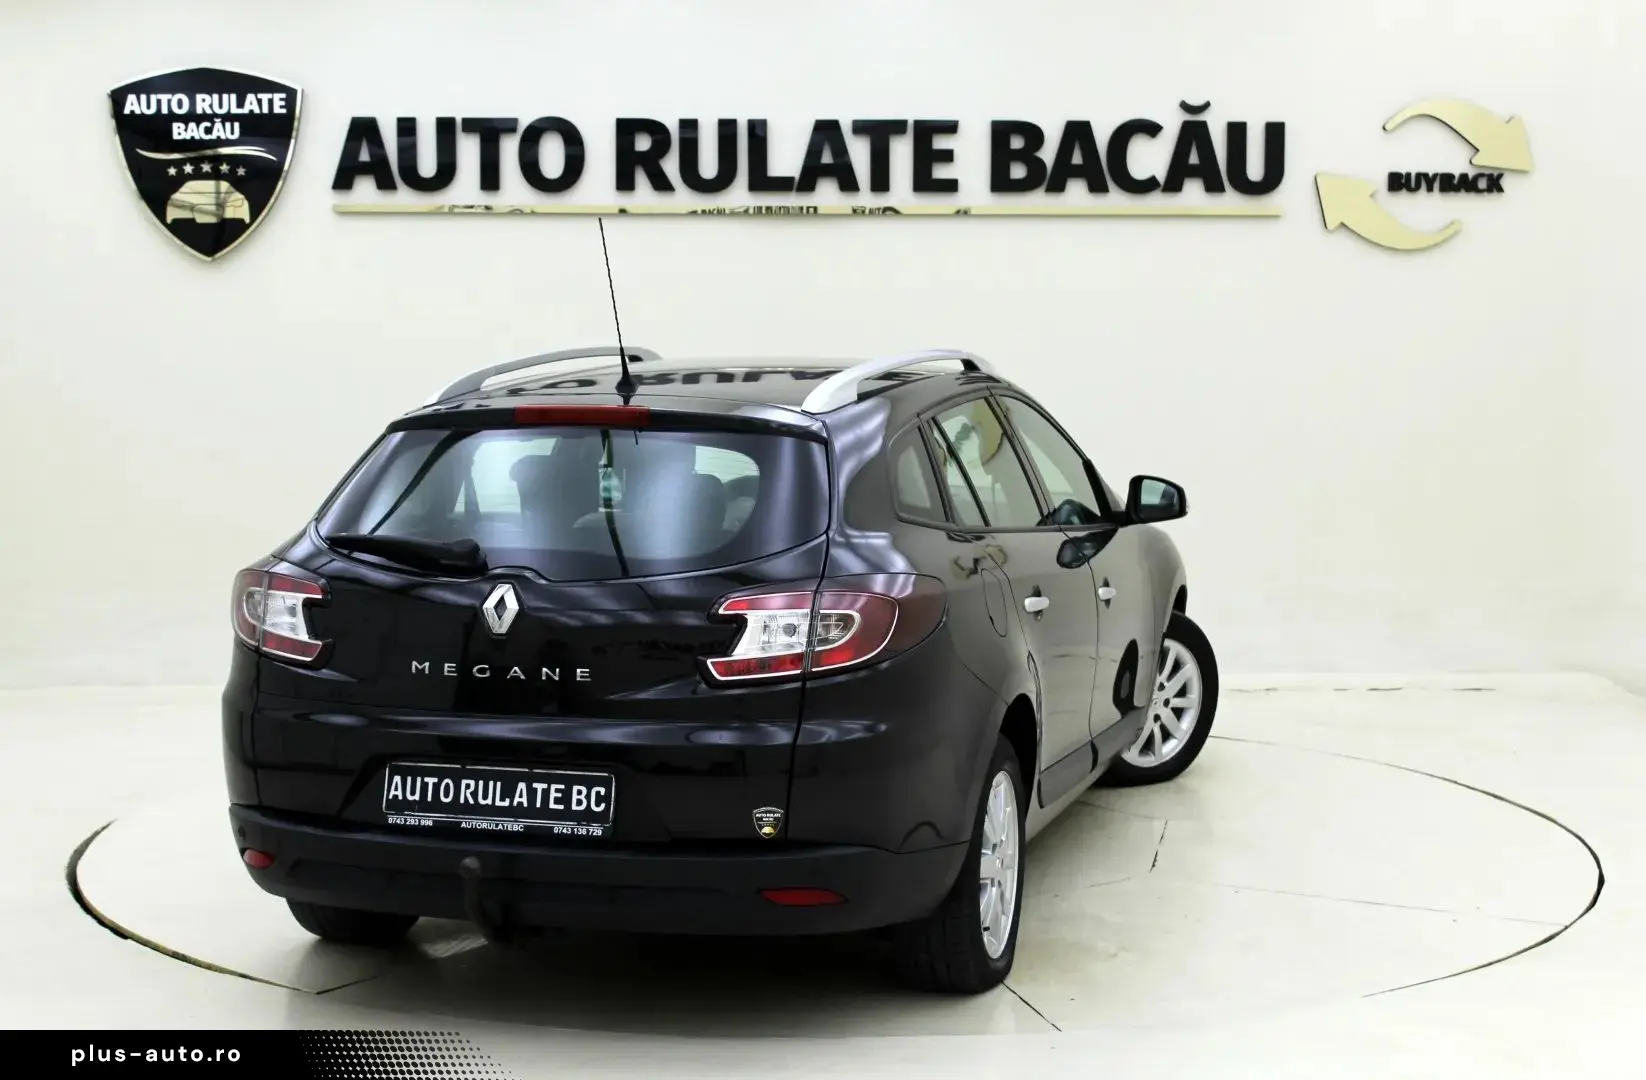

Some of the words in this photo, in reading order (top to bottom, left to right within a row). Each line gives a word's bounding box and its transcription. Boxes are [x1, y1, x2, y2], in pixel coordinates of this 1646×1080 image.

[124, 93, 189, 115] AUTO
[196, 93, 287, 114] RULATE
[172, 118, 240, 140] BACĂU
[331, 116, 585, 193] AUTO
[615, 117, 959, 194] RULATE
[990, 100, 1286, 196] BACĂU
[1387, 171, 1504, 193] BUYBACK
[411, 660, 591, 681] MEGANE
[388, 775, 454, 803] AUTO
[460, 779, 565, 810] RULATE
[571, 785, 606, 812] BC
[388, 817, 404, 825] 0743
[460, 821, 524, 831] AUTORULATEBC
[553, 826, 571, 834] 0743
[588, 828, 602, 836] 729
